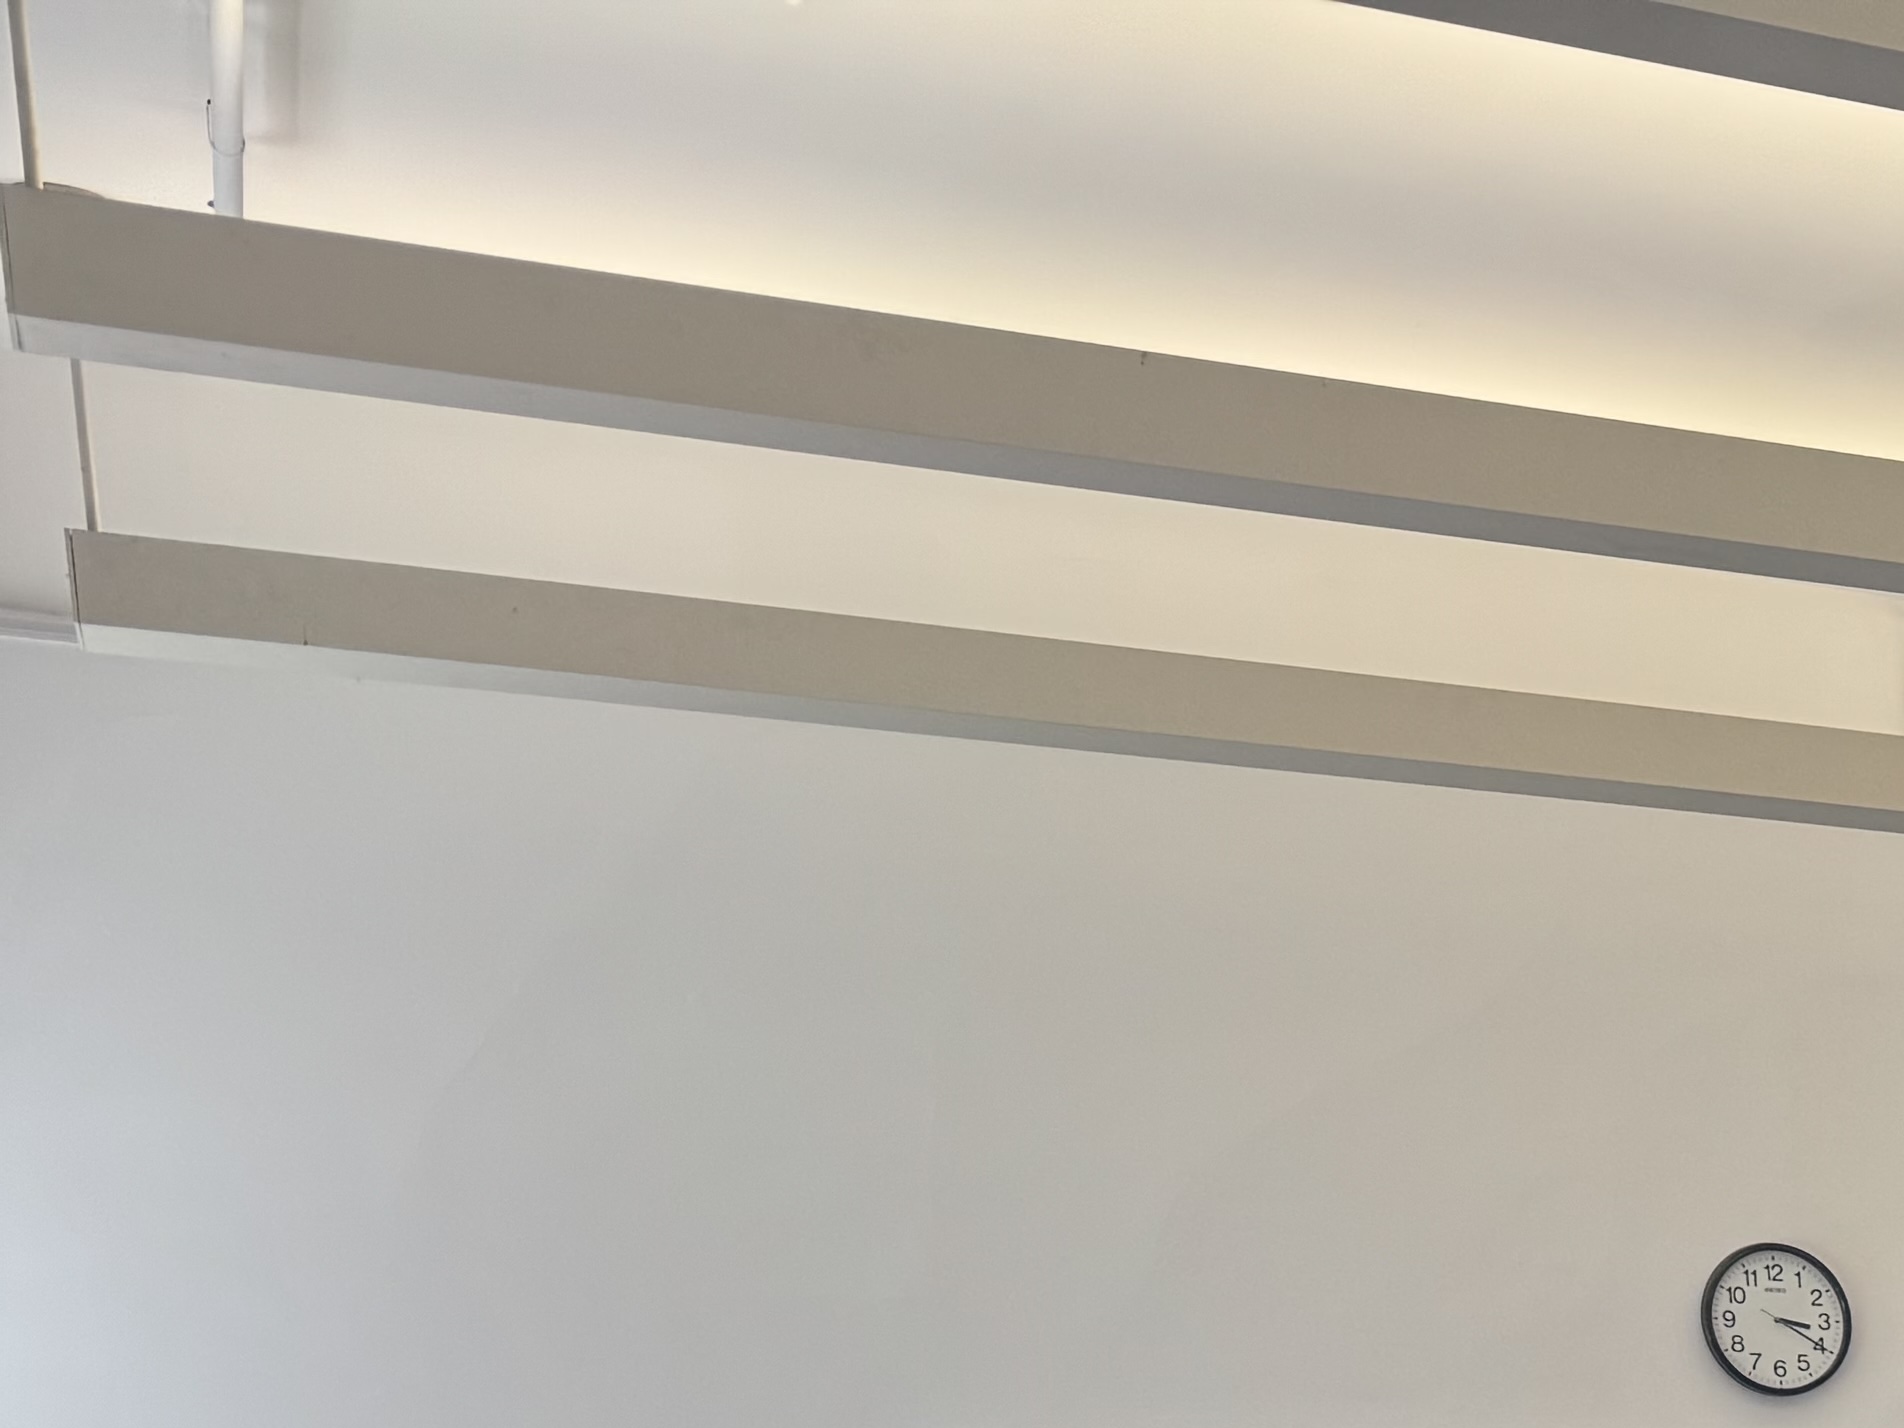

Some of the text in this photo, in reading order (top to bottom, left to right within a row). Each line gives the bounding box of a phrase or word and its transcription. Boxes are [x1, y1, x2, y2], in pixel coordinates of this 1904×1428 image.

[1744, 1270, 1757, 1287] 11
[1764, 1264, 1783, 1281] 12
[1794, 1272, 1801, 1288] 1
[1726, 1287, 1746, 1304] 10
[1811, 1289, 1823, 1306] 2
[1723, 1310, 1736, 1328] 9
[1818, 1313, 1831, 1330] 3
[1731, 1335, 1745, 1352] 8
[1813, 1337, 1825, 1354] 4
[1749, 1353, 1762, 1370] 7
[1774, 1360, 1787, 1377] 6
[1797, 1354, 1810, 1371] 5
